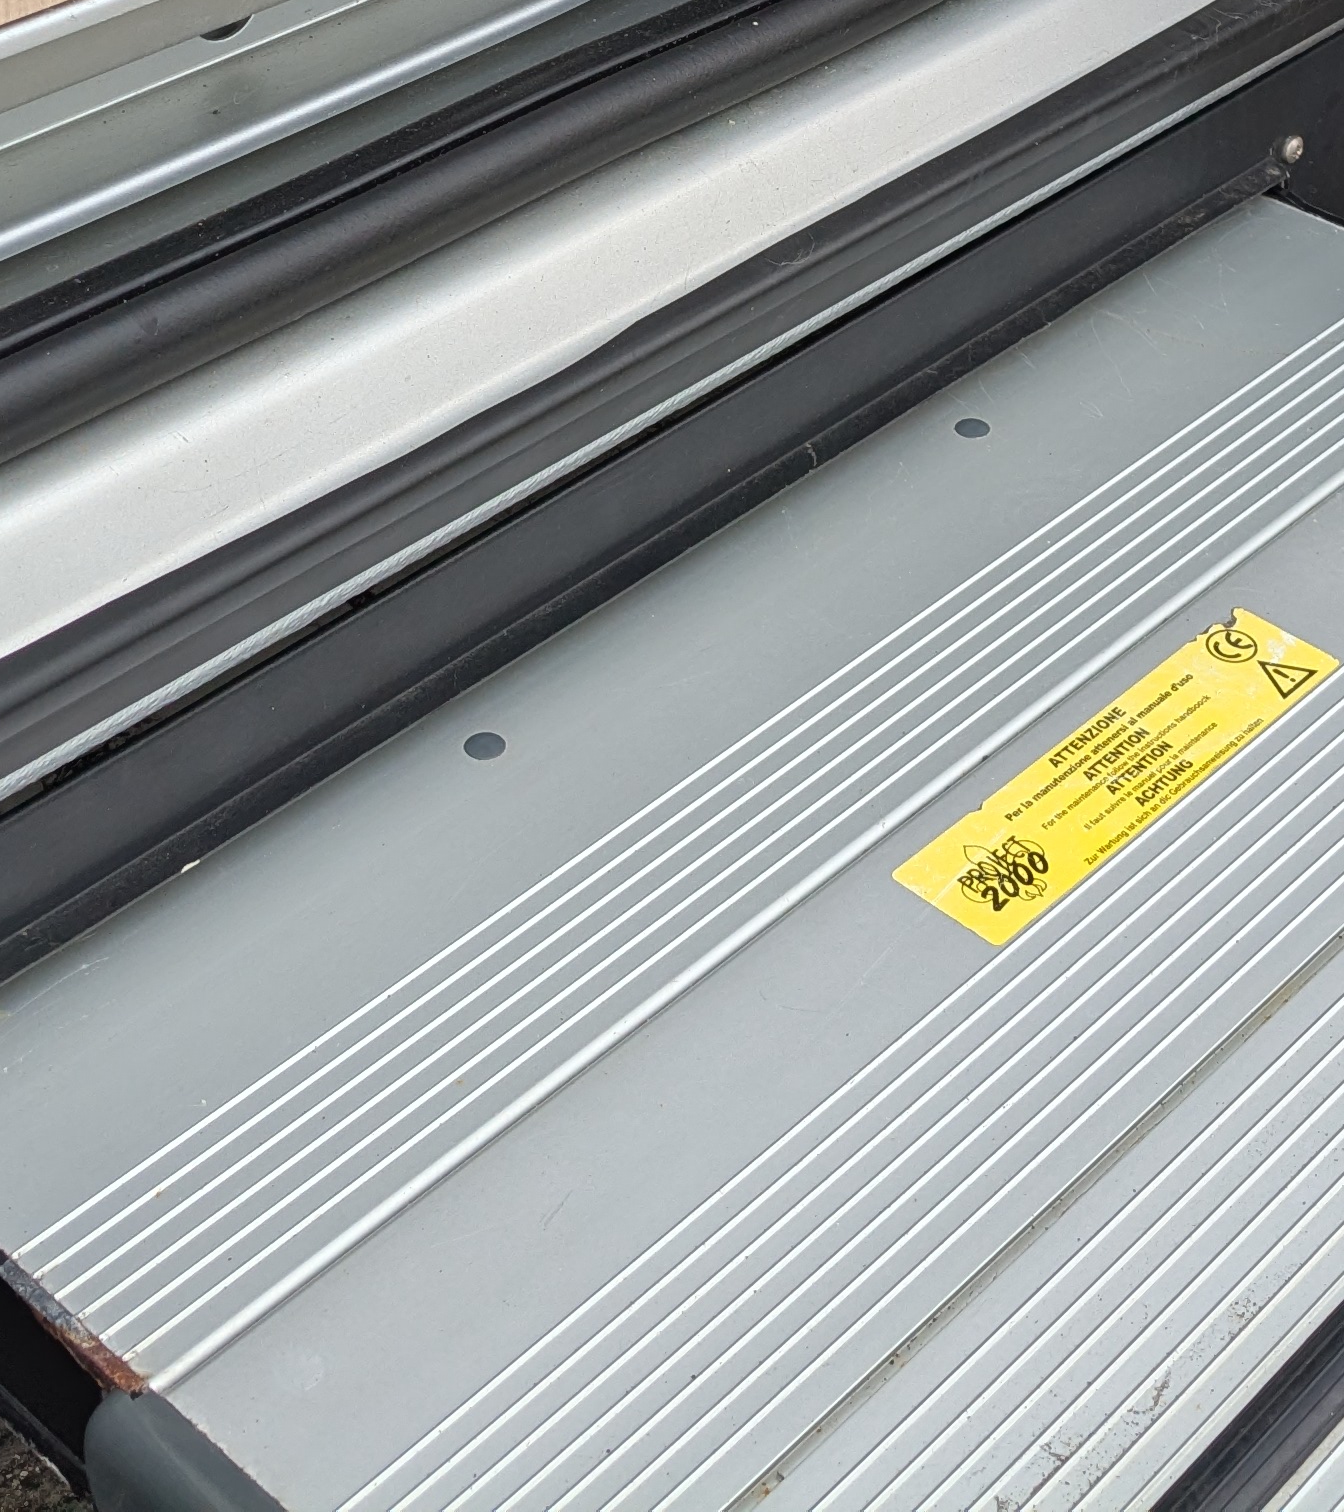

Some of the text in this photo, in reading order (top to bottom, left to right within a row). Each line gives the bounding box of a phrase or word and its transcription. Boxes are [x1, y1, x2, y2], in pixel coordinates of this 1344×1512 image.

[1213, 631, 1254, 658] CE
[1004, 673, 1194, 822] Per la manutenzione attenersi al manuale d'uso
[1048, 706, 1127, 769] ATTENZIONE
[1082, 727, 1150, 782] ATTENTION
[1105, 740, 1174, 796] ATTENTION
[1041, 818, 1057, 831] For
[1053, 809, 1069, 820] the
[1066, 776, 1110, 811] maintenance
[1106, 760, 1130, 778] follow
[1126, 751, 1141, 762] the
[1083, 853, 1100, 866] Zur
[1096, 830, 1130, 854] Wartung
[1123, 821, 1138, 832] ist
[1135, 810, 1153, 825] sich
[1149, 803, 1162, 813] an
[1234, 733, 1246, 743] zu
[1240, 718, 1265, 736] halten
[1088, 812, 1107, 826] faut
[1104, 796, 1127, 815] suivre
[1123, 790, 1134, 798] le
[1131, 771, 1157, 793] manuel
[1155, 758, 1173, 774] pour
[1168, 753, 1180, 761] la
[1177, 722, 1218, 756] maintenance
[1134, 759, 1194, 808] ACHTUNG
[956, 835, 1031, 894] PROJECT
[979, 851, 1049, 912] 2000
